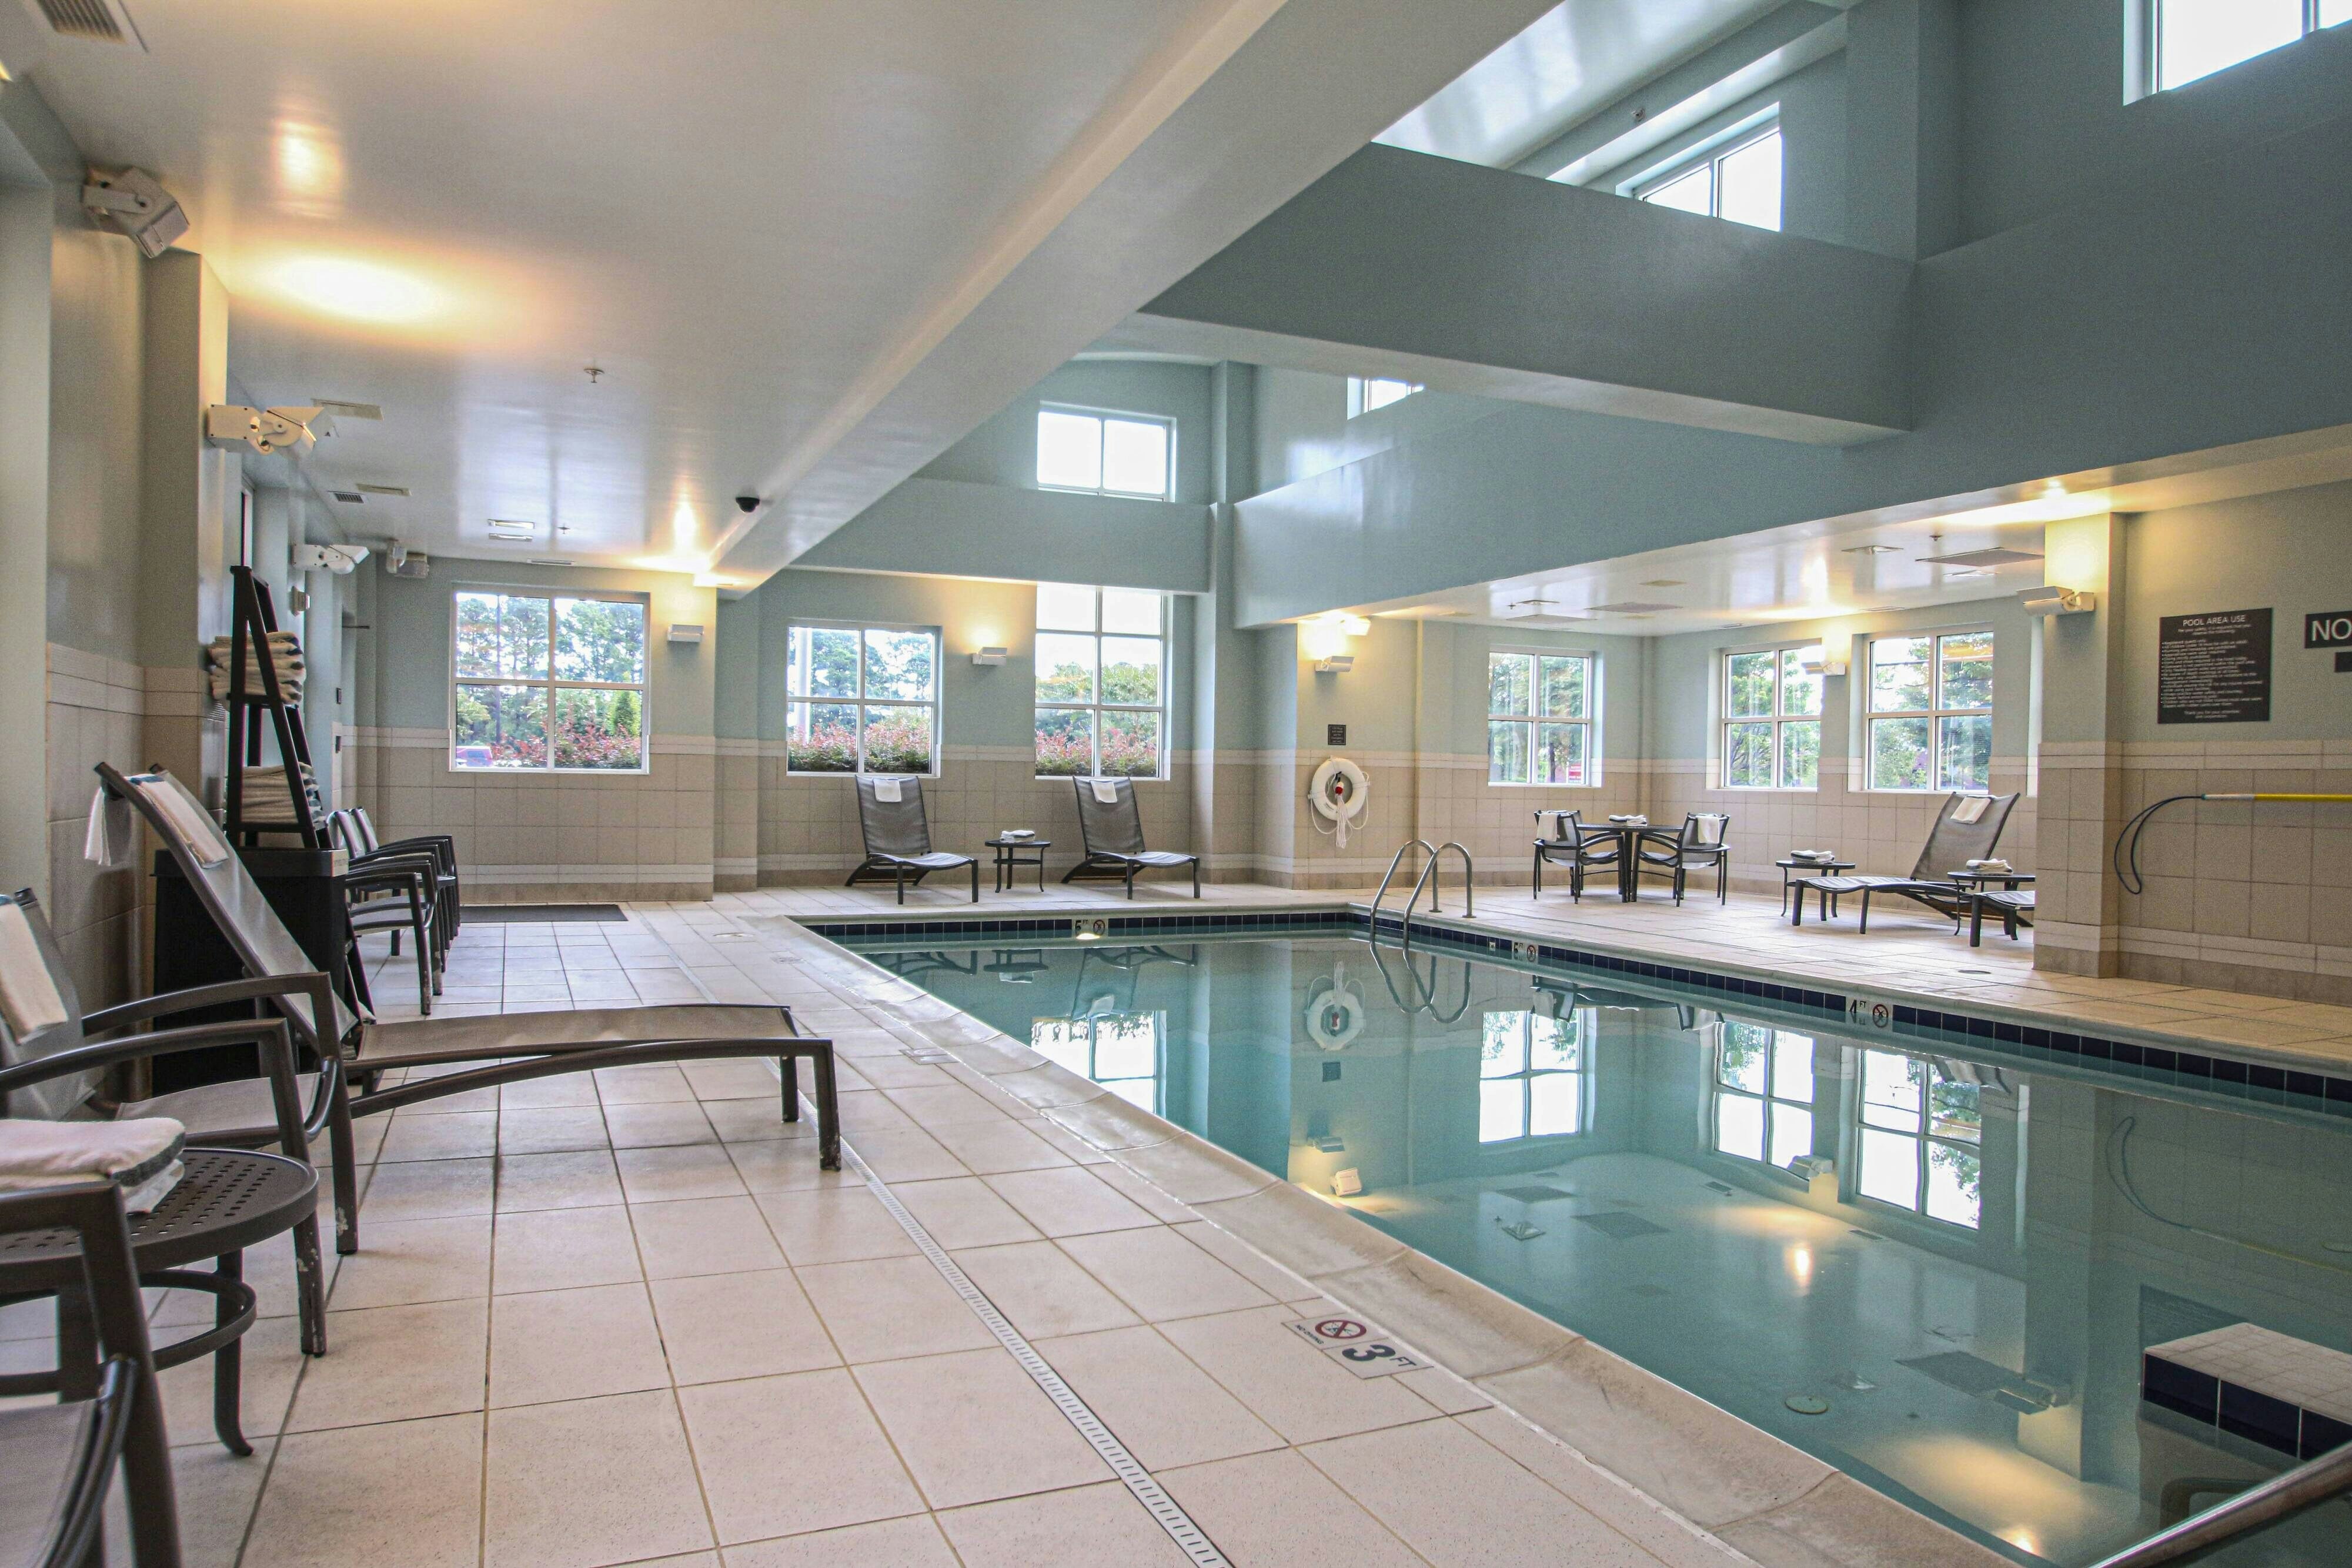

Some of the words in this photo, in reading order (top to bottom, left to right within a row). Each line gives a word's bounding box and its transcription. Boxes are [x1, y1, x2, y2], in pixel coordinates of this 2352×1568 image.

[2206, 616, 2227, 624] AREA
[1342, 1345, 1396, 1361] 3
[1389, 1356, 1416, 1366] FT
